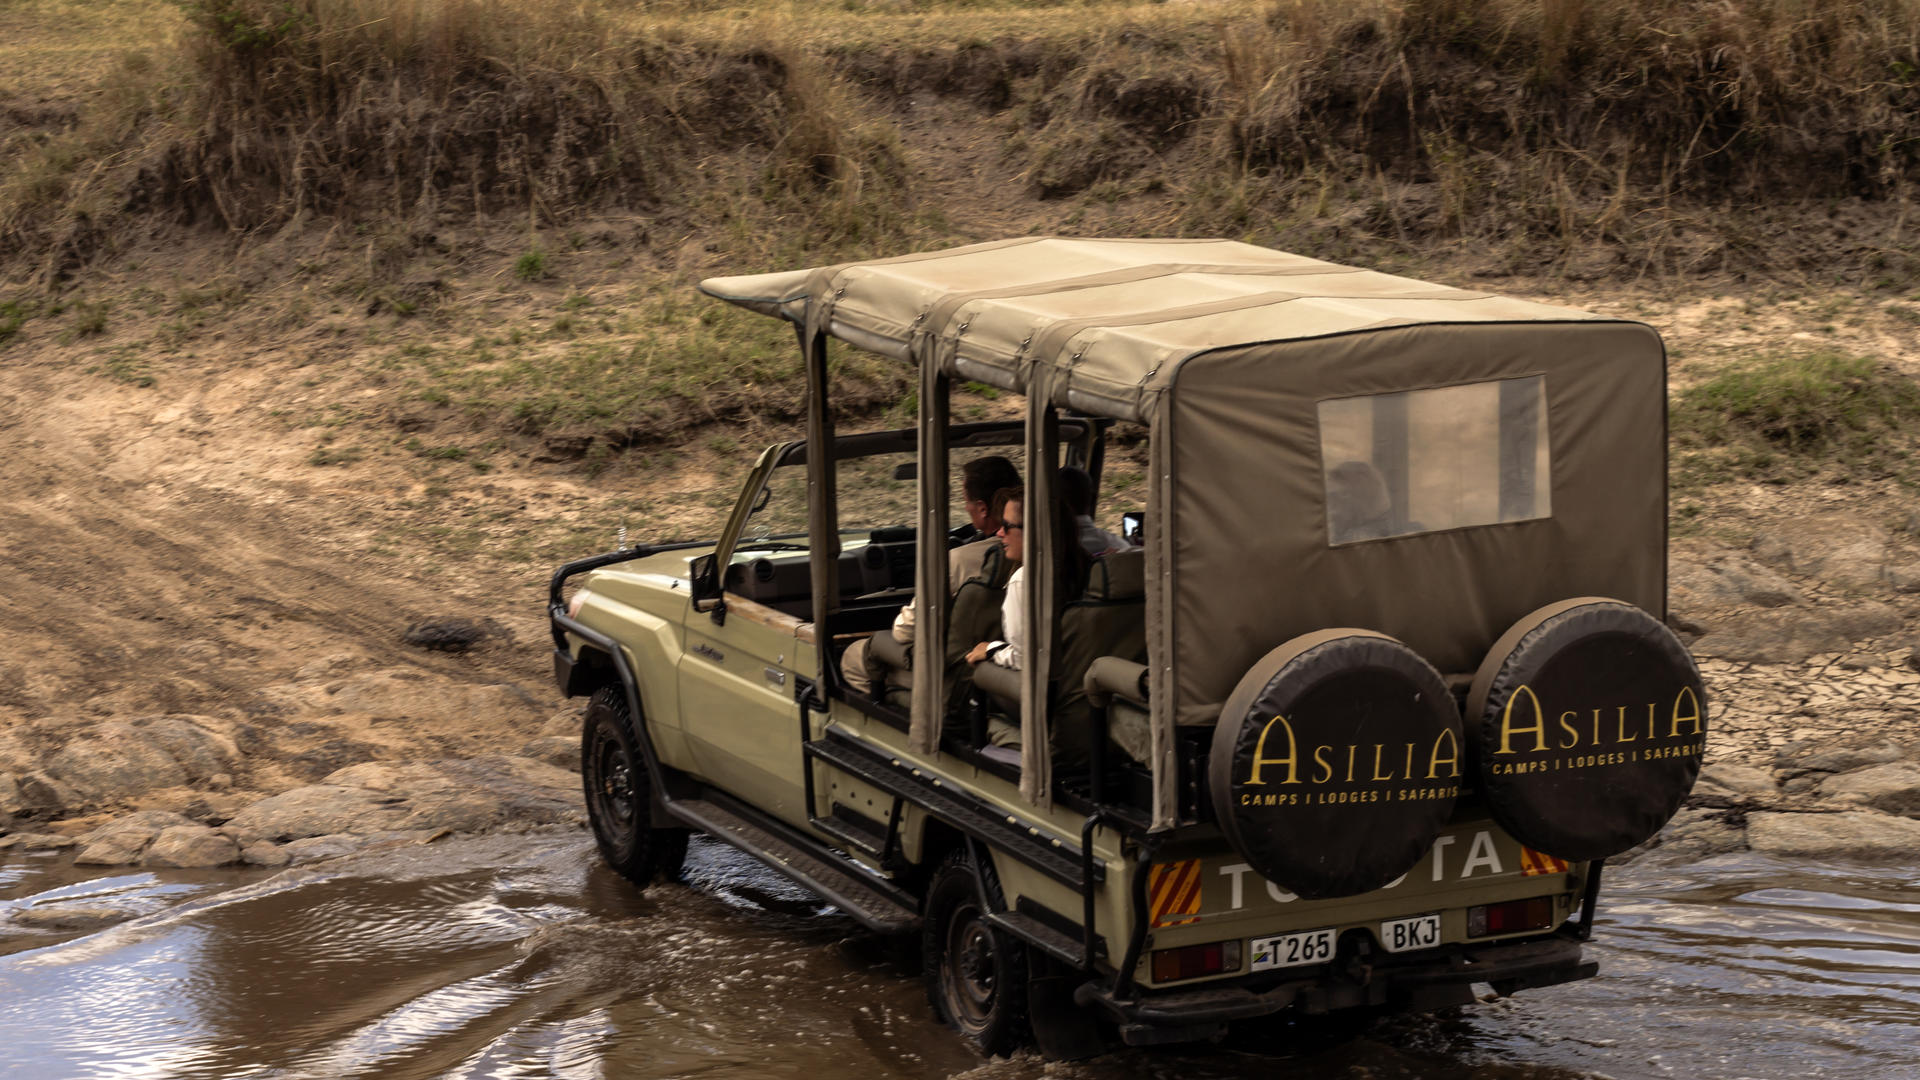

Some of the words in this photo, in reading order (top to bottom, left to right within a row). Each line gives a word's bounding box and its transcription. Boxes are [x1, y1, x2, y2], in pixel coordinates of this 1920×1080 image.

[1493, 684, 1704, 754] ASILIA
[1243, 714, 1461, 785] ASILIA
[1492, 760, 1548, 775] CAMPS
[1567, 752, 1625, 769] LODGES
[1241, 793, 1298, 806] CAMPS
[1319, 790, 1379, 804] LODGES
[1398, 785, 1459, 801] SAFARIS
[1393, 919, 1437, 949] BKJ
